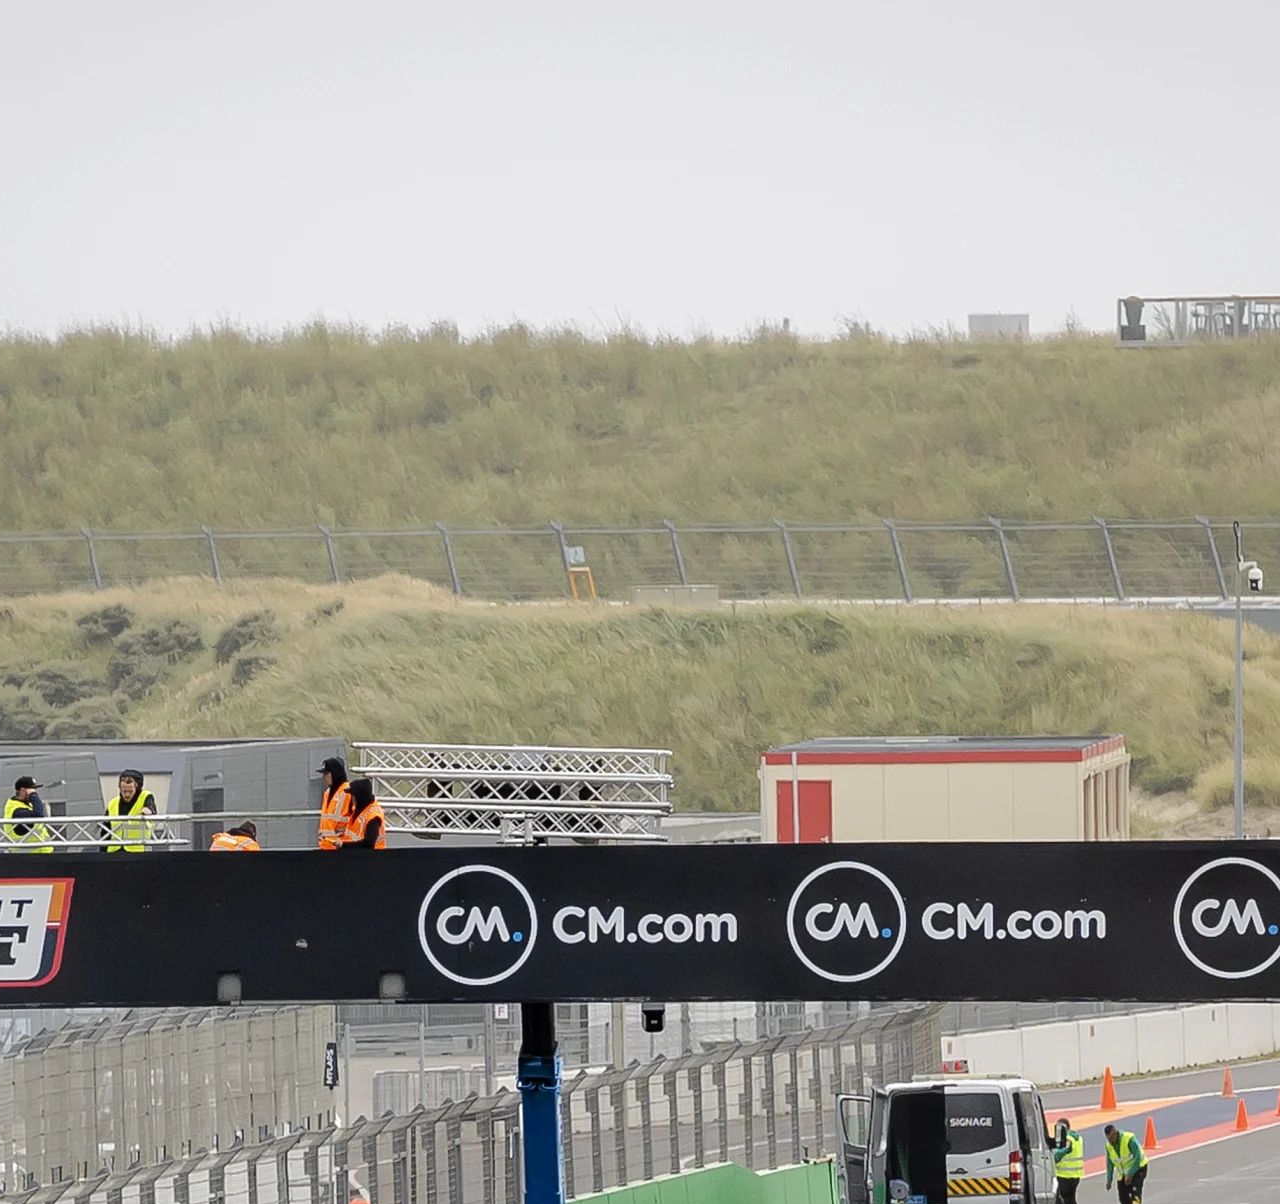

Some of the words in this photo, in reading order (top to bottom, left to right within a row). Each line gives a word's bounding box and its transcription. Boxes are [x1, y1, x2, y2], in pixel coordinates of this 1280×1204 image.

[552, 906, 738, 943] CM.com
[921, 902, 1106, 940] CM.com
[949, 1117, 993, 1127] SIGNAGE
